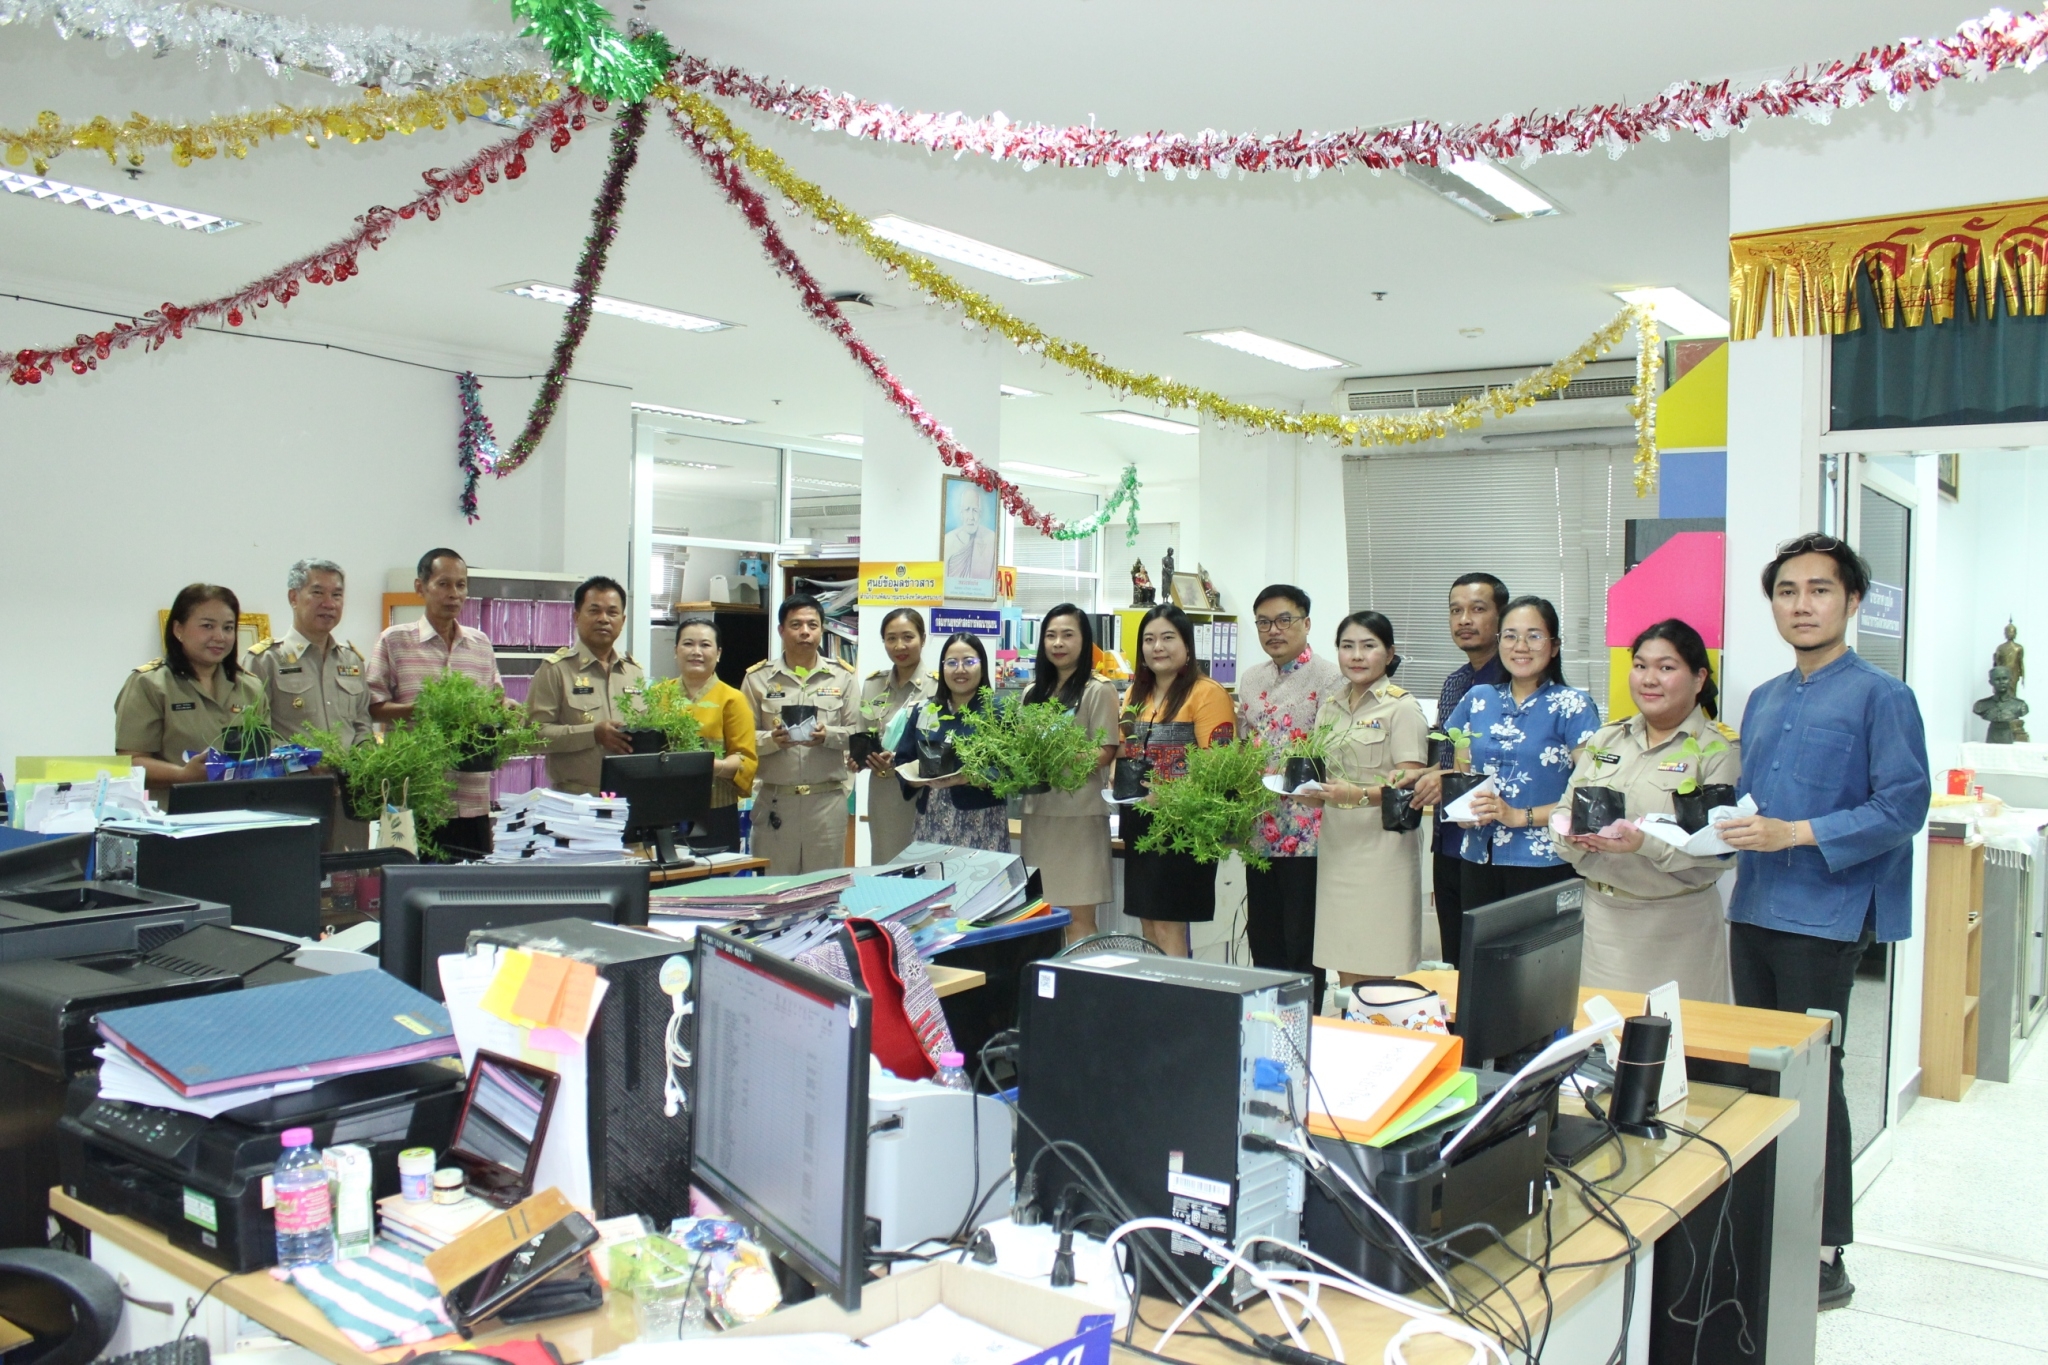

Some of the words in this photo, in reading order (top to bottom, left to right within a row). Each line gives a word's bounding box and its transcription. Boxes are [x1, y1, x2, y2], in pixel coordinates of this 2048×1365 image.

[866, 574, 935, 592] ศูนย์ข้อมูลข่าวสาร
